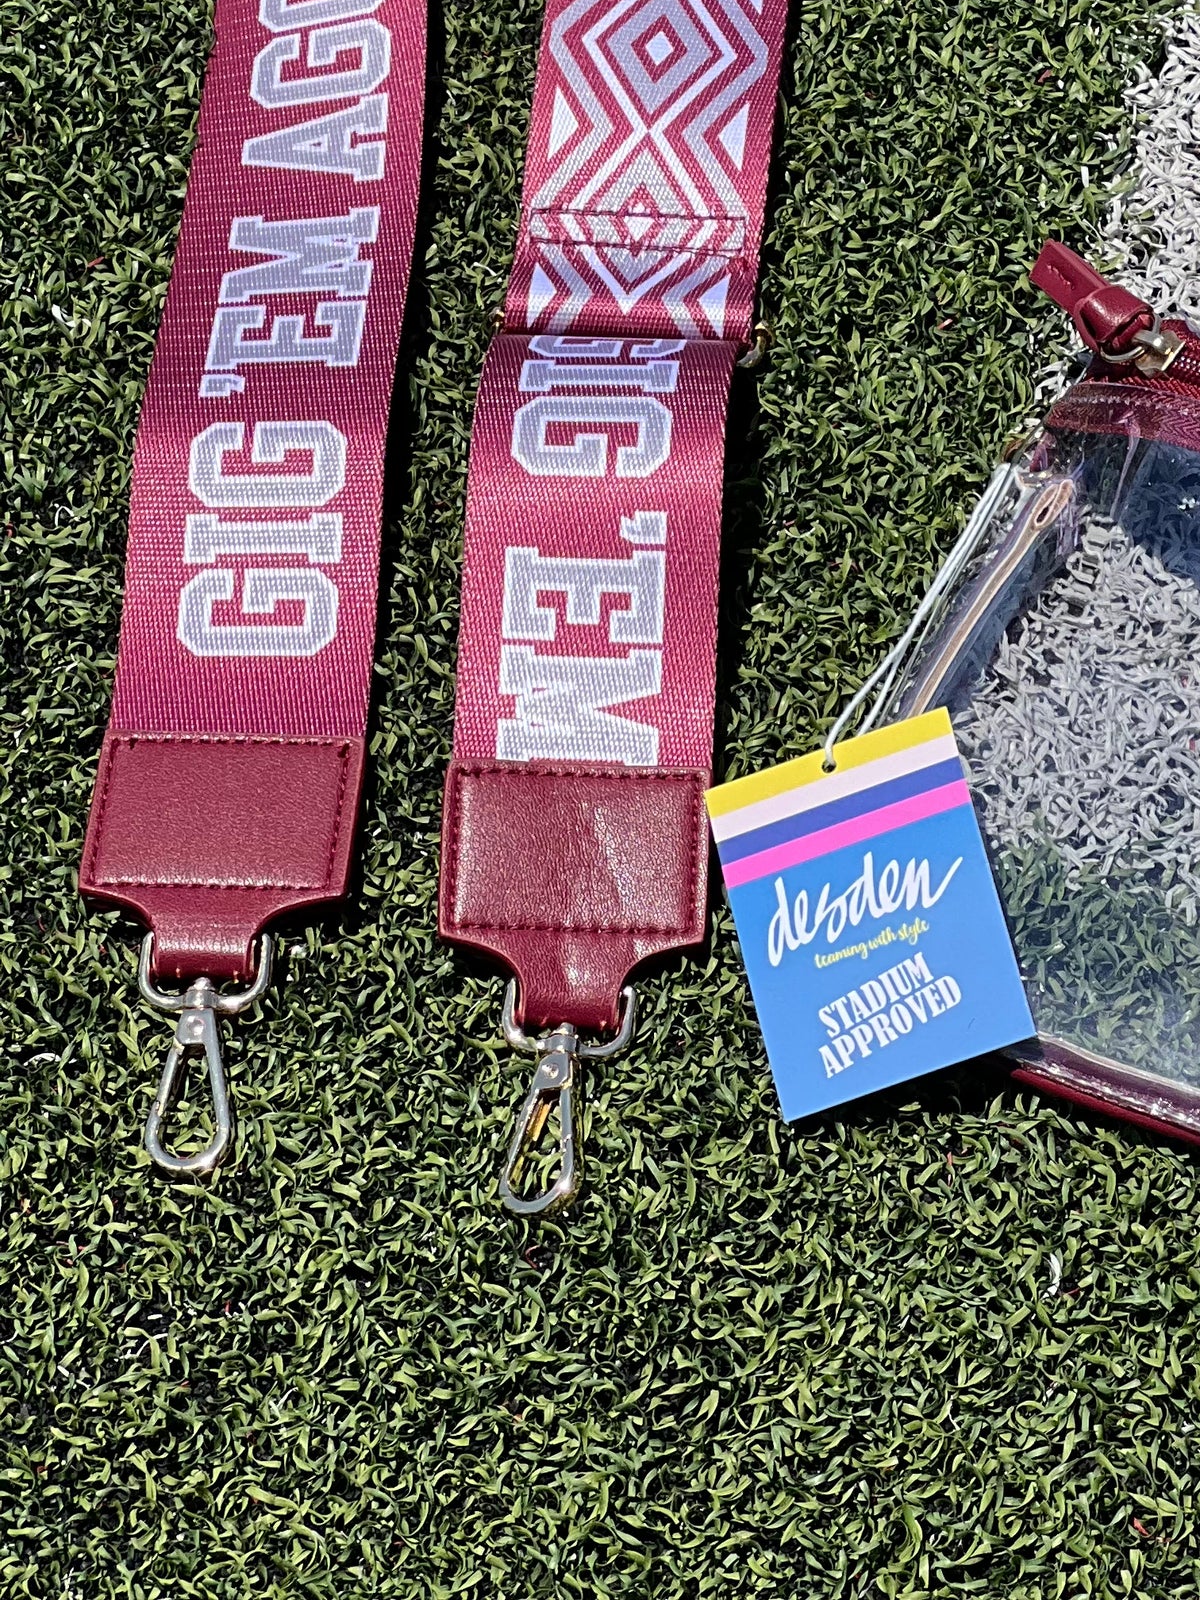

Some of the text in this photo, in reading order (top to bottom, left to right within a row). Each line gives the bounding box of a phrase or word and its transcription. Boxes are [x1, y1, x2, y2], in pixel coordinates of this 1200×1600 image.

[198, 206, 381, 397] 'EM
[176, 420, 347, 656] GIG
[496, 510, 668, 766] 'EM
[768, 851, 963, 967] desden
[814, 917, 930, 969] teaming with style
[818, 952, 934, 1038] STADIUM
[818, 975, 962, 1079] APPROVED
